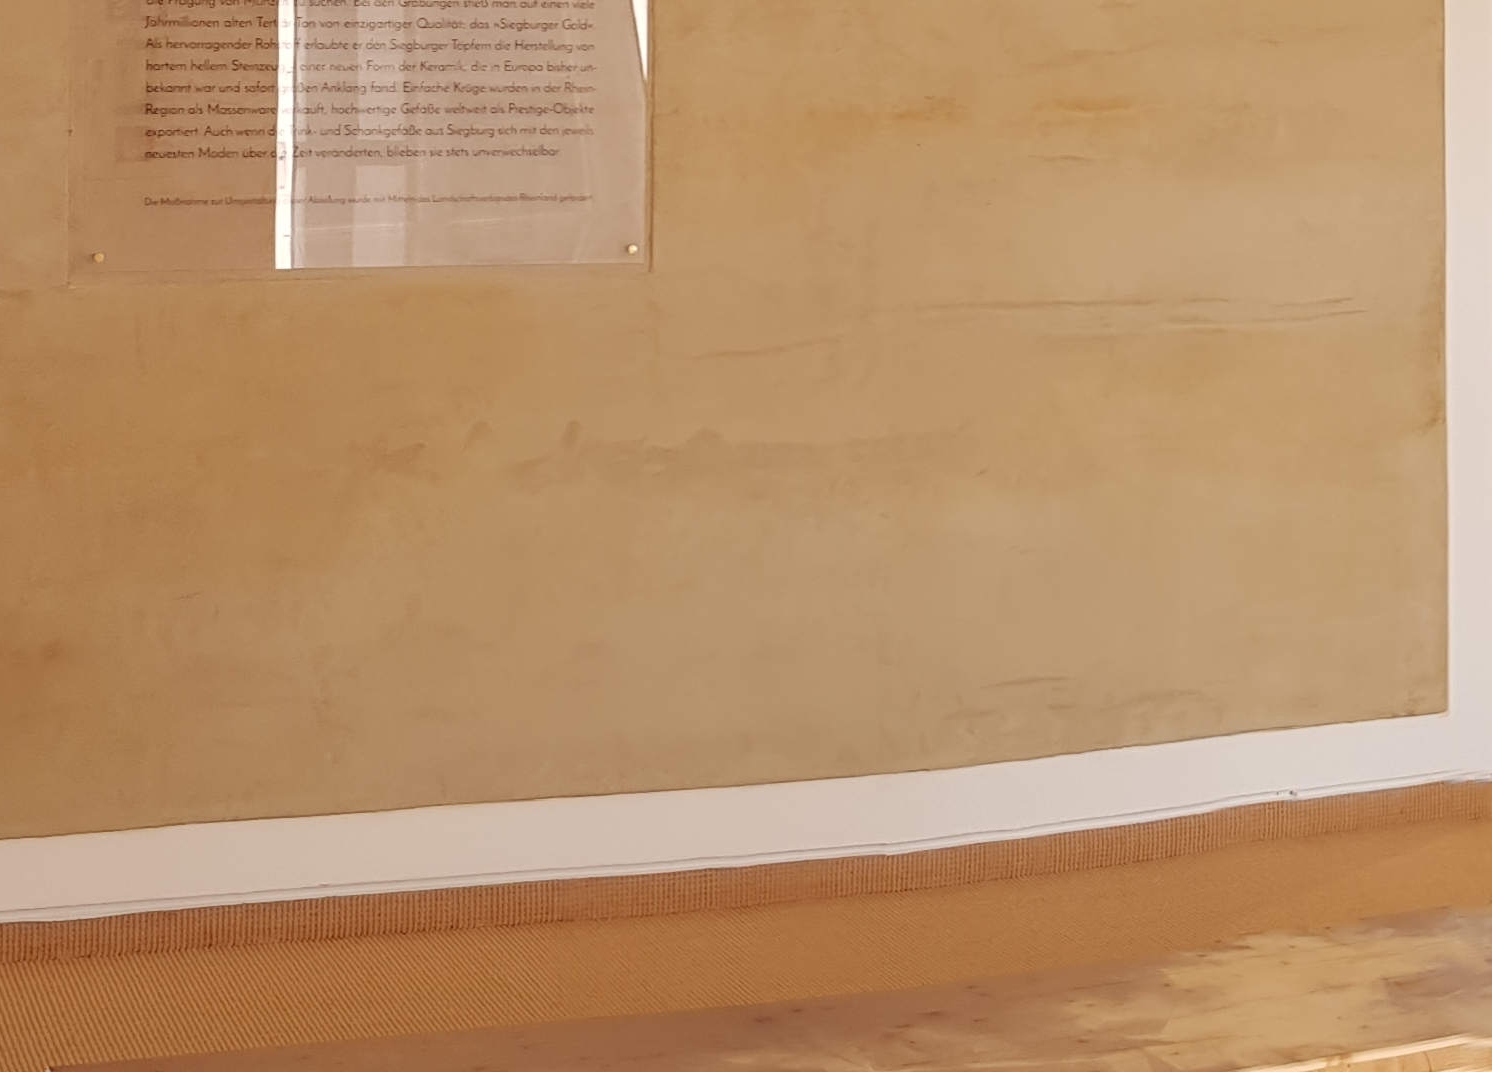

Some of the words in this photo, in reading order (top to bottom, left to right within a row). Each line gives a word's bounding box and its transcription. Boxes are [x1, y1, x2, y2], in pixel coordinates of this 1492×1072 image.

[492, 0, 517, 9] man
[541, 0, 569, 9] einen
[572, 0, 595, 9] viele
[144, 16, 219, 28] Jahrmillionen
[224, 17, 252, 28] alten
[319, 19, 340, 28] von
[470, 19, 489, 29] das
[146, 38, 163, 49] Als
[166, 38, 252, 52] hervorragender
[305, 39, 349, 50] erlaubte
[352, 42, 363, 50] er
[366, 40, 386, 50] den
[388, 39, 448, 53] Siegburger
[494, 40, 511, 50] die
[514, 40, 573, 54] Herstellung
[576, 42, 595, 51] von
[146, 59, 186, 71] hartem
[191, 59, 227, 71] hellem
[329, 63, 363, 72] neuen
[366, 60, 395, 71] Form
[399, 61, 416, 71] der
[470, 61, 487, 72] die
[504, 61, 543, 73] Europa
[547, 62, 577, 72] bisher
[146, 81, 191, 93] bekannt
[194, 84, 216, 93] war
[219, 81, 241, 93] und
[244, 81, 277, 93] sofort
[322, 82, 366, 96] Anklang
[403, 82, 450, 93] Einfache
[489, 82, 528, 93] wurden
[531, 83, 541, 93] in
[544, 82, 561, 93] der
[145, 104, 183, 117] Region
[188, 104, 203, 115] als
[207, 104, 277, 115] Massenware
[491, 104, 505, 114] als
[508, 103, 595, 116] Prestige-Objekte
[203, 126, 234, 136] Auch
[236, 128, 265, 137] wenn
[320, 126, 341, 136] und
[424, 127, 444, 137] aus
[447, 124, 495, 138] Siegburg
[498, 125, 517, 137] sich
[520, 126, 536, 137] mit
[539, 125, 559, 137] den
[144, 147, 195, 159] neuesten
[198, 147, 238, 159] Moden
[243, 146, 268, 158] über
[293, 146, 312, 158] Zeit
[387, 146, 426, 158] blieben
[430, 147, 444, 158] sie
[447, 147, 469, 158] stets
